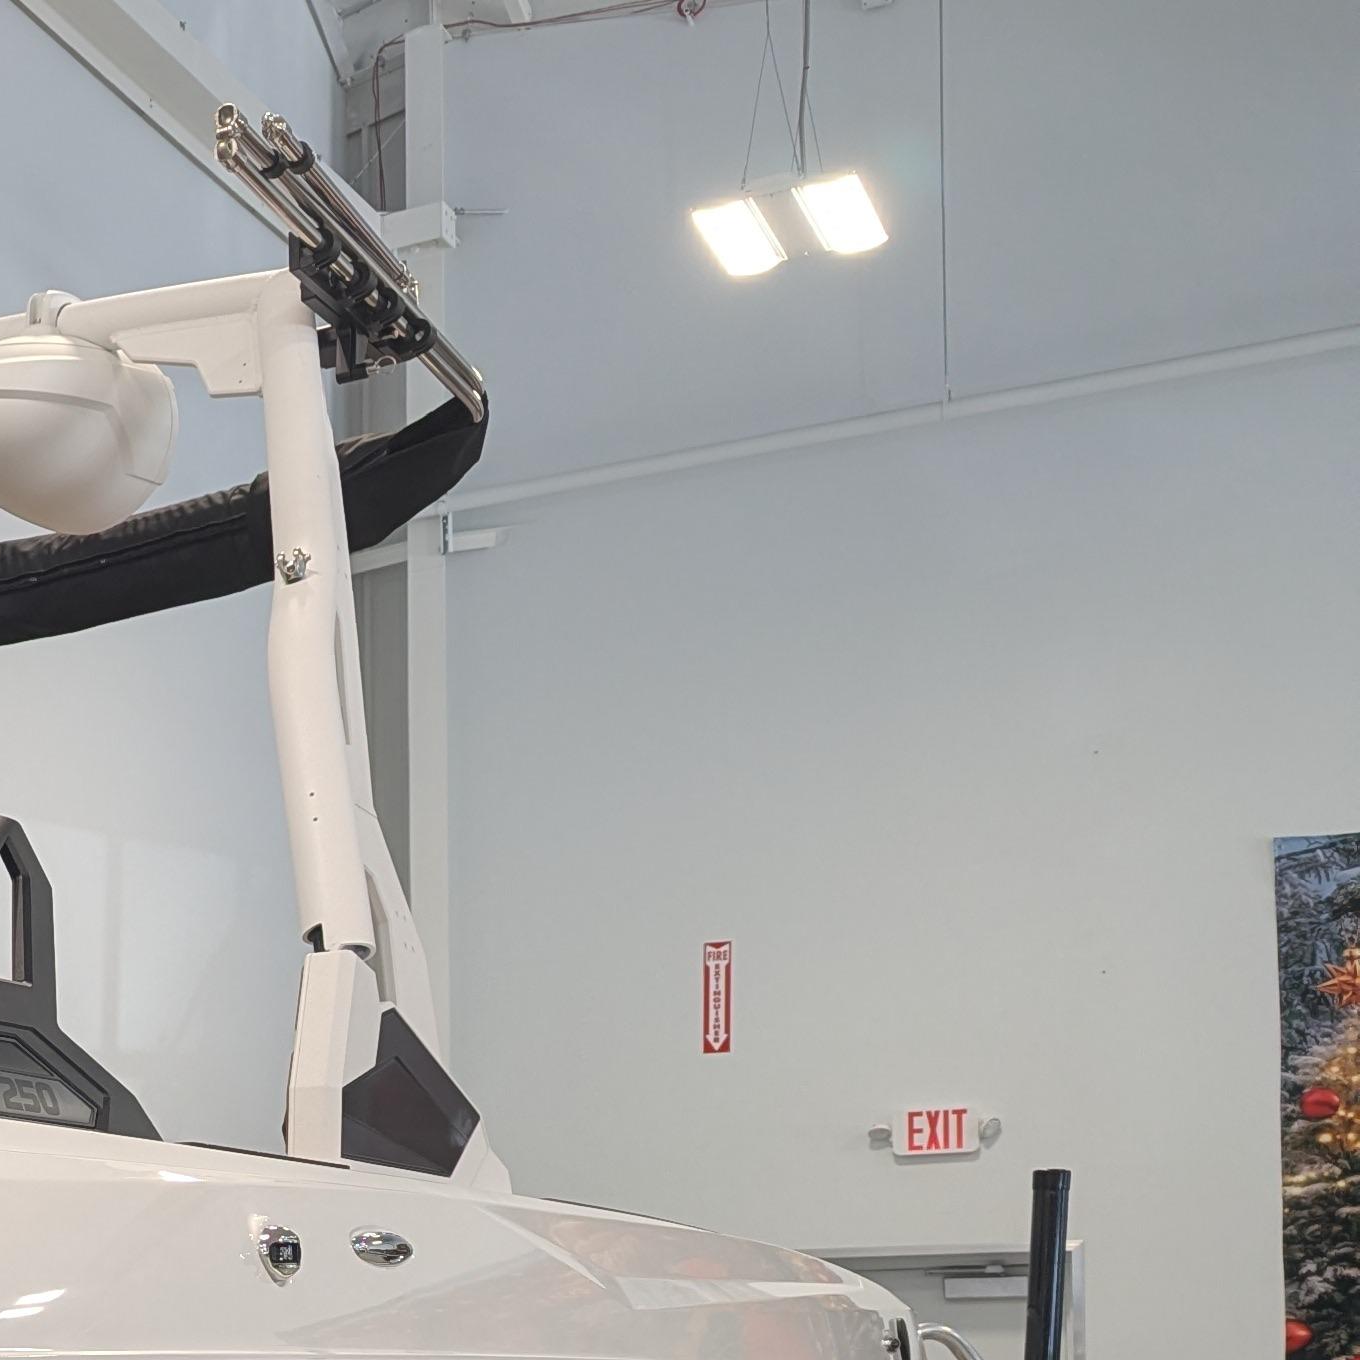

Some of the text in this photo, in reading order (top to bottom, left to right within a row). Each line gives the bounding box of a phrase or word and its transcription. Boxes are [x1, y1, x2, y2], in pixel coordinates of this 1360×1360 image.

[707, 950, 728, 961] FIRE
[713, 963, 721, 1043] EXTINGUISHER
[907, 1108, 968, 1151] EXIT
